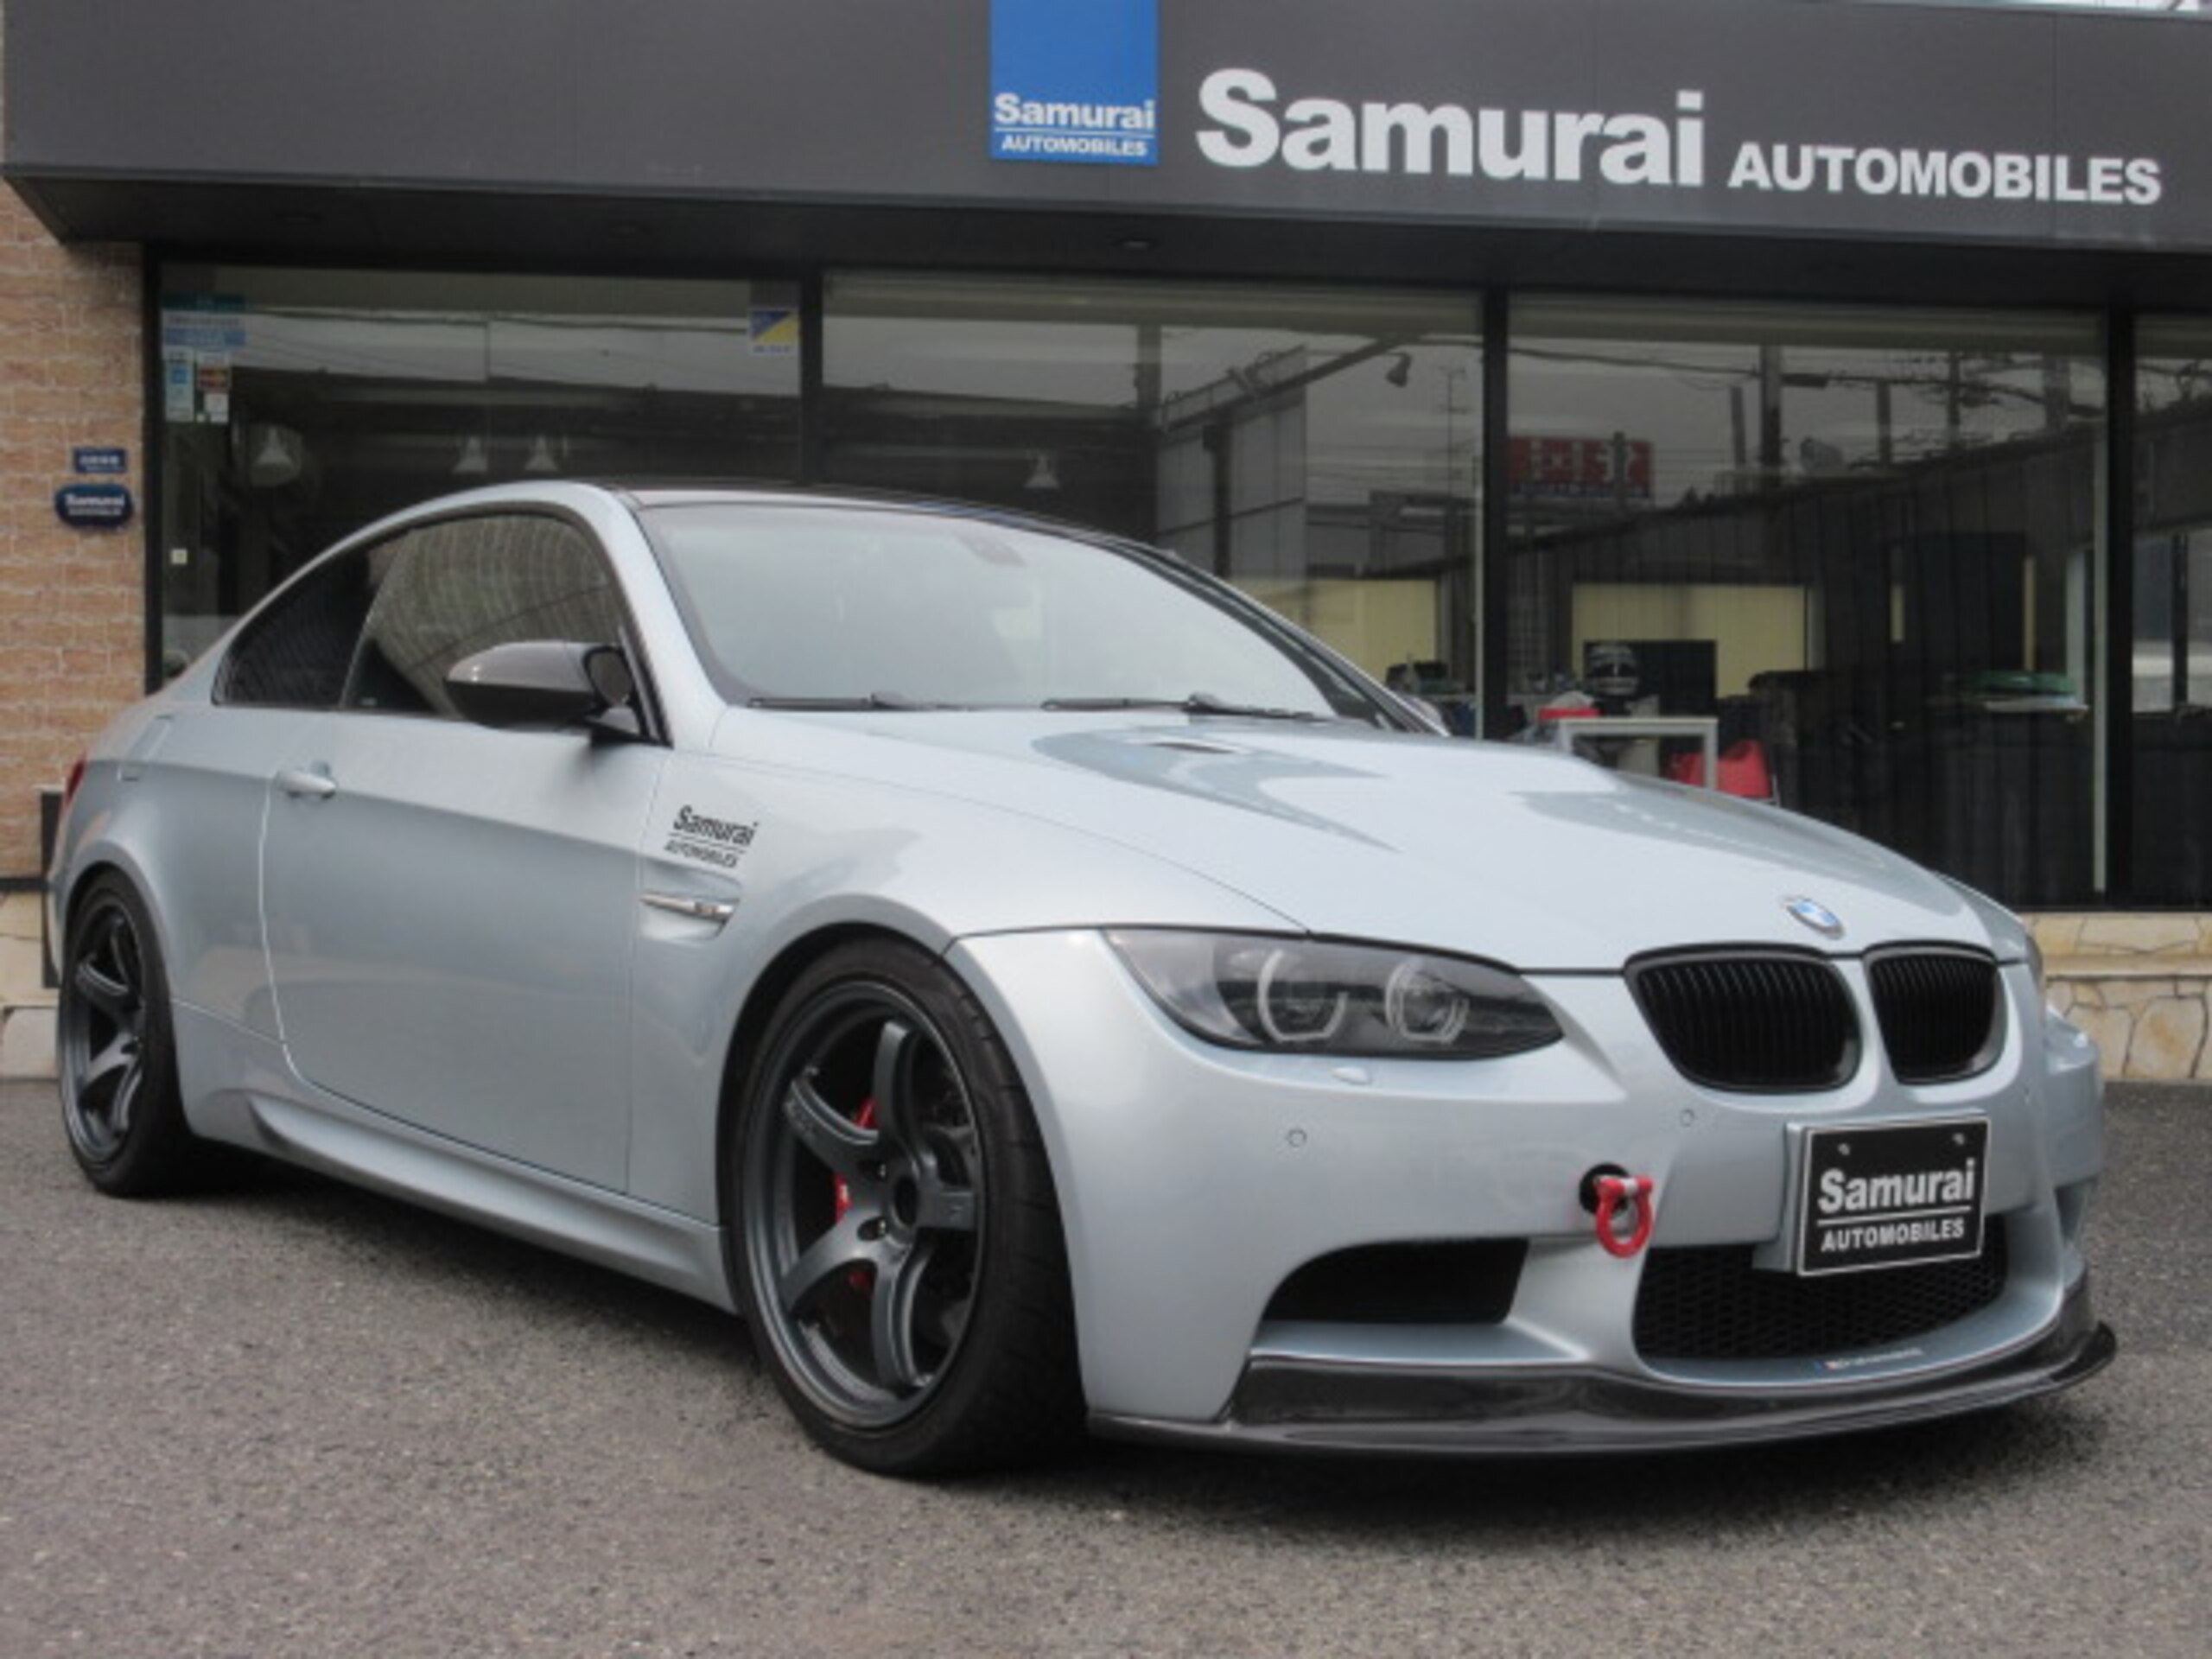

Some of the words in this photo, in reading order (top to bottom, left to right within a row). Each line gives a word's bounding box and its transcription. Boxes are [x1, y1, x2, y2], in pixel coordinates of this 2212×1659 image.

[995, 92, 1156, 130] Samurai
[1001, 135, 1147, 157] AUTOMOBILES
[1197, 67, 1704, 187] Samurai
[1727, 142, 2163, 206] AUTOMOBILES
[673, 804, 760, 846] Samurai
[664, 839, 740, 868] AUTOMOBILES
[1817, 1158, 1975, 1213] Samurai
[1821, 1218, 1965, 1253] AUTOMOBILES
